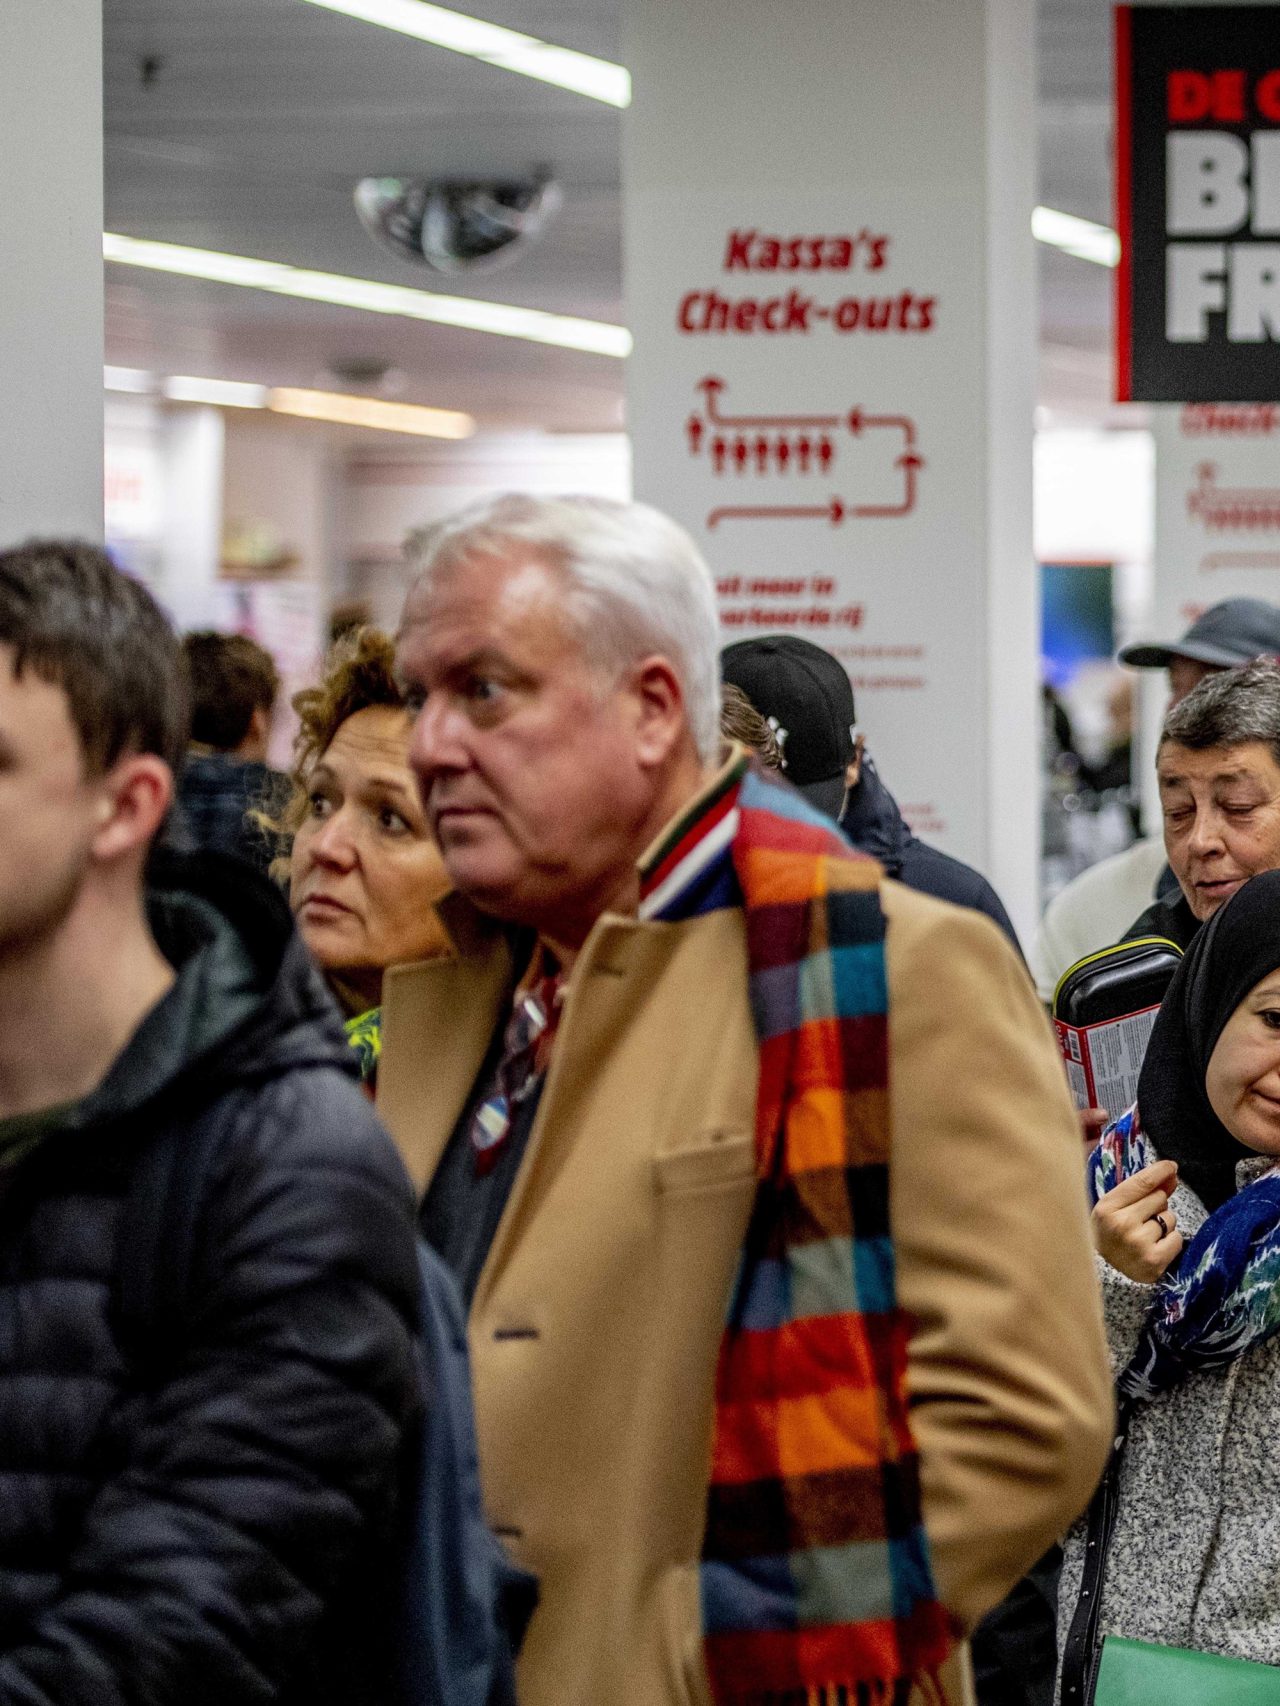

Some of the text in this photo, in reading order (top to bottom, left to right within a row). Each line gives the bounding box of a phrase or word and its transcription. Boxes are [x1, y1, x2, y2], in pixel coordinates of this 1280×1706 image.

[1167, 70, 1247, 123] DE
[724, 230, 891, 275] Kassa's
[677, 289, 939, 336] Check-outs
